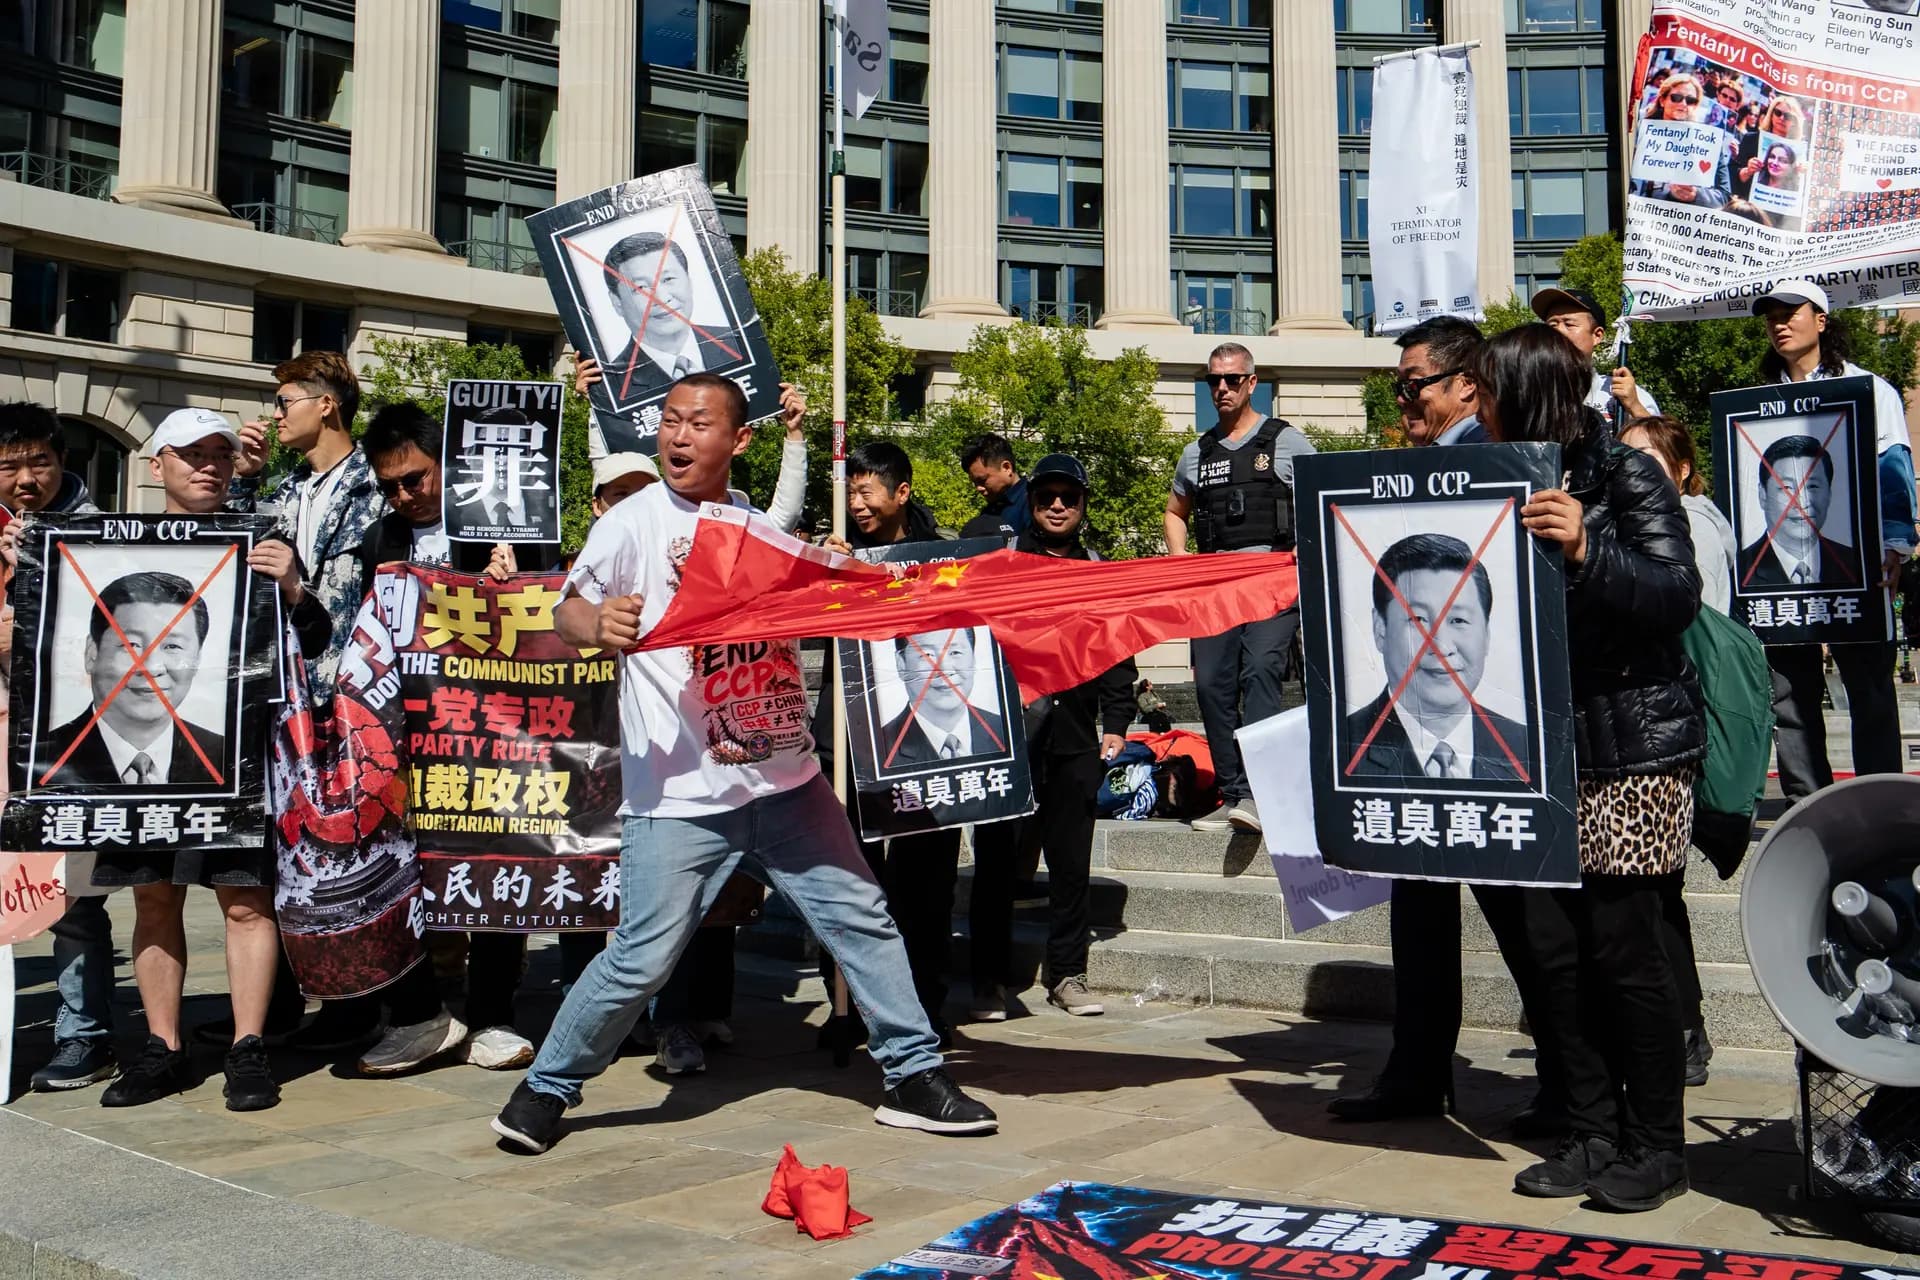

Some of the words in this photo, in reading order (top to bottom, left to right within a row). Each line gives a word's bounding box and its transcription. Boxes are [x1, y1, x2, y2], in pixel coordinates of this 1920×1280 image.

[1831, 8, 1882, 28] Yaoning
[1886, 17, 1913, 31] Sun
[1825, 37, 1871, 55] Partner
[1827, 22, 1865, 39] Eileen
[1869, 29, 1913, 48] Wang's
[1666, 21, 1748, 63] Fentanyl
[1751, 52, 1799, 86] Crisis
[1806, 73, 1853, 96] from
[1861, 84, 1908, 104] CCP
[1646, 124, 1690, 141] Fentanyl
[1694, 128, 1717, 144] Took
[1856, 139, 1877, 151] THE
[1880, 142, 1917, 153] FACES
[1646, 139, 1661, 153] My
[1665, 141, 1709, 156] Daughter
[1864, 153, 1905, 164] BEHIND
[1642, 155, 1680, 169] Forever
[1683, 161, 1693, 172] 19
[1848, 163, 1868, 175] THE
[585, 204, 615, 226] END
[1391, 218, 1462, 231] TERMINATOR
[1392, 234, 1407, 244] OF
[1409, 231, 1460, 242] FREEDOM
[1694, 212, 1707, 223] of
[1709, 214, 1754, 236] fentanyl
[1757, 228, 1781, 243] from
[1807, 235, 1834, 245] CCP
[1837, 229, 1879, 241] causes
[1655, 237, 1693, 254] million
[1696, 245, 1737, 264] deaths.
[1742, 254, 1763, 268] The
[1693, 228, 1755, 251] Americans
[1758, 245, 1784, 258] each
[1637, 261, 1671, 276] States
[1675, 271, 1690, 283] via
[1661, 252, 1721, 275] precursors
[1691, 276, 1800, 304] EMOCRA
[453, 382, 559, 410] GUILTY!
[1760, 400, 1786, 417] END
[1793, 396, 1820, 413] CCP
[452, 419, 551, 507] 罪
[1212, 459, 1231, 469] PARK
[1371, 475, 1414, 499] END
[1428, 471, 1471, 495] CCP
[102, 519, 143, 541] END
[157, 520, 198, 541] CCP
[1748, 596, 1862, 628] 遺臭萬年
[401, 652, 440, 675] THE
[444, 656, 568, 685] COMMUNIST
[574, 660, 617, 685] PAR
[702, 642, 768, 677] END
[704, 661, 775, 705] CCP
[736, 701, 760, 718] CCP
[411, 733, 488, 758] PARTY
[492, 741, 552, 763] RULE
[891, 768, 1014, 814] 遺臭萬年
[41, 803, 228, 846] 遺臭萬年
[416, 814, 504, 833] HORITARIAN
[508, 816, 569, 836] REGIME
[1352, 798, 1537, 851] 遺臭萬年
[0, 864, 67, 915] othes
[425, 912, 489, 926] GHTER
[504, 914, 584, 927] FUTURE
[1120, 1233, 1411, 1280] PROTEST
